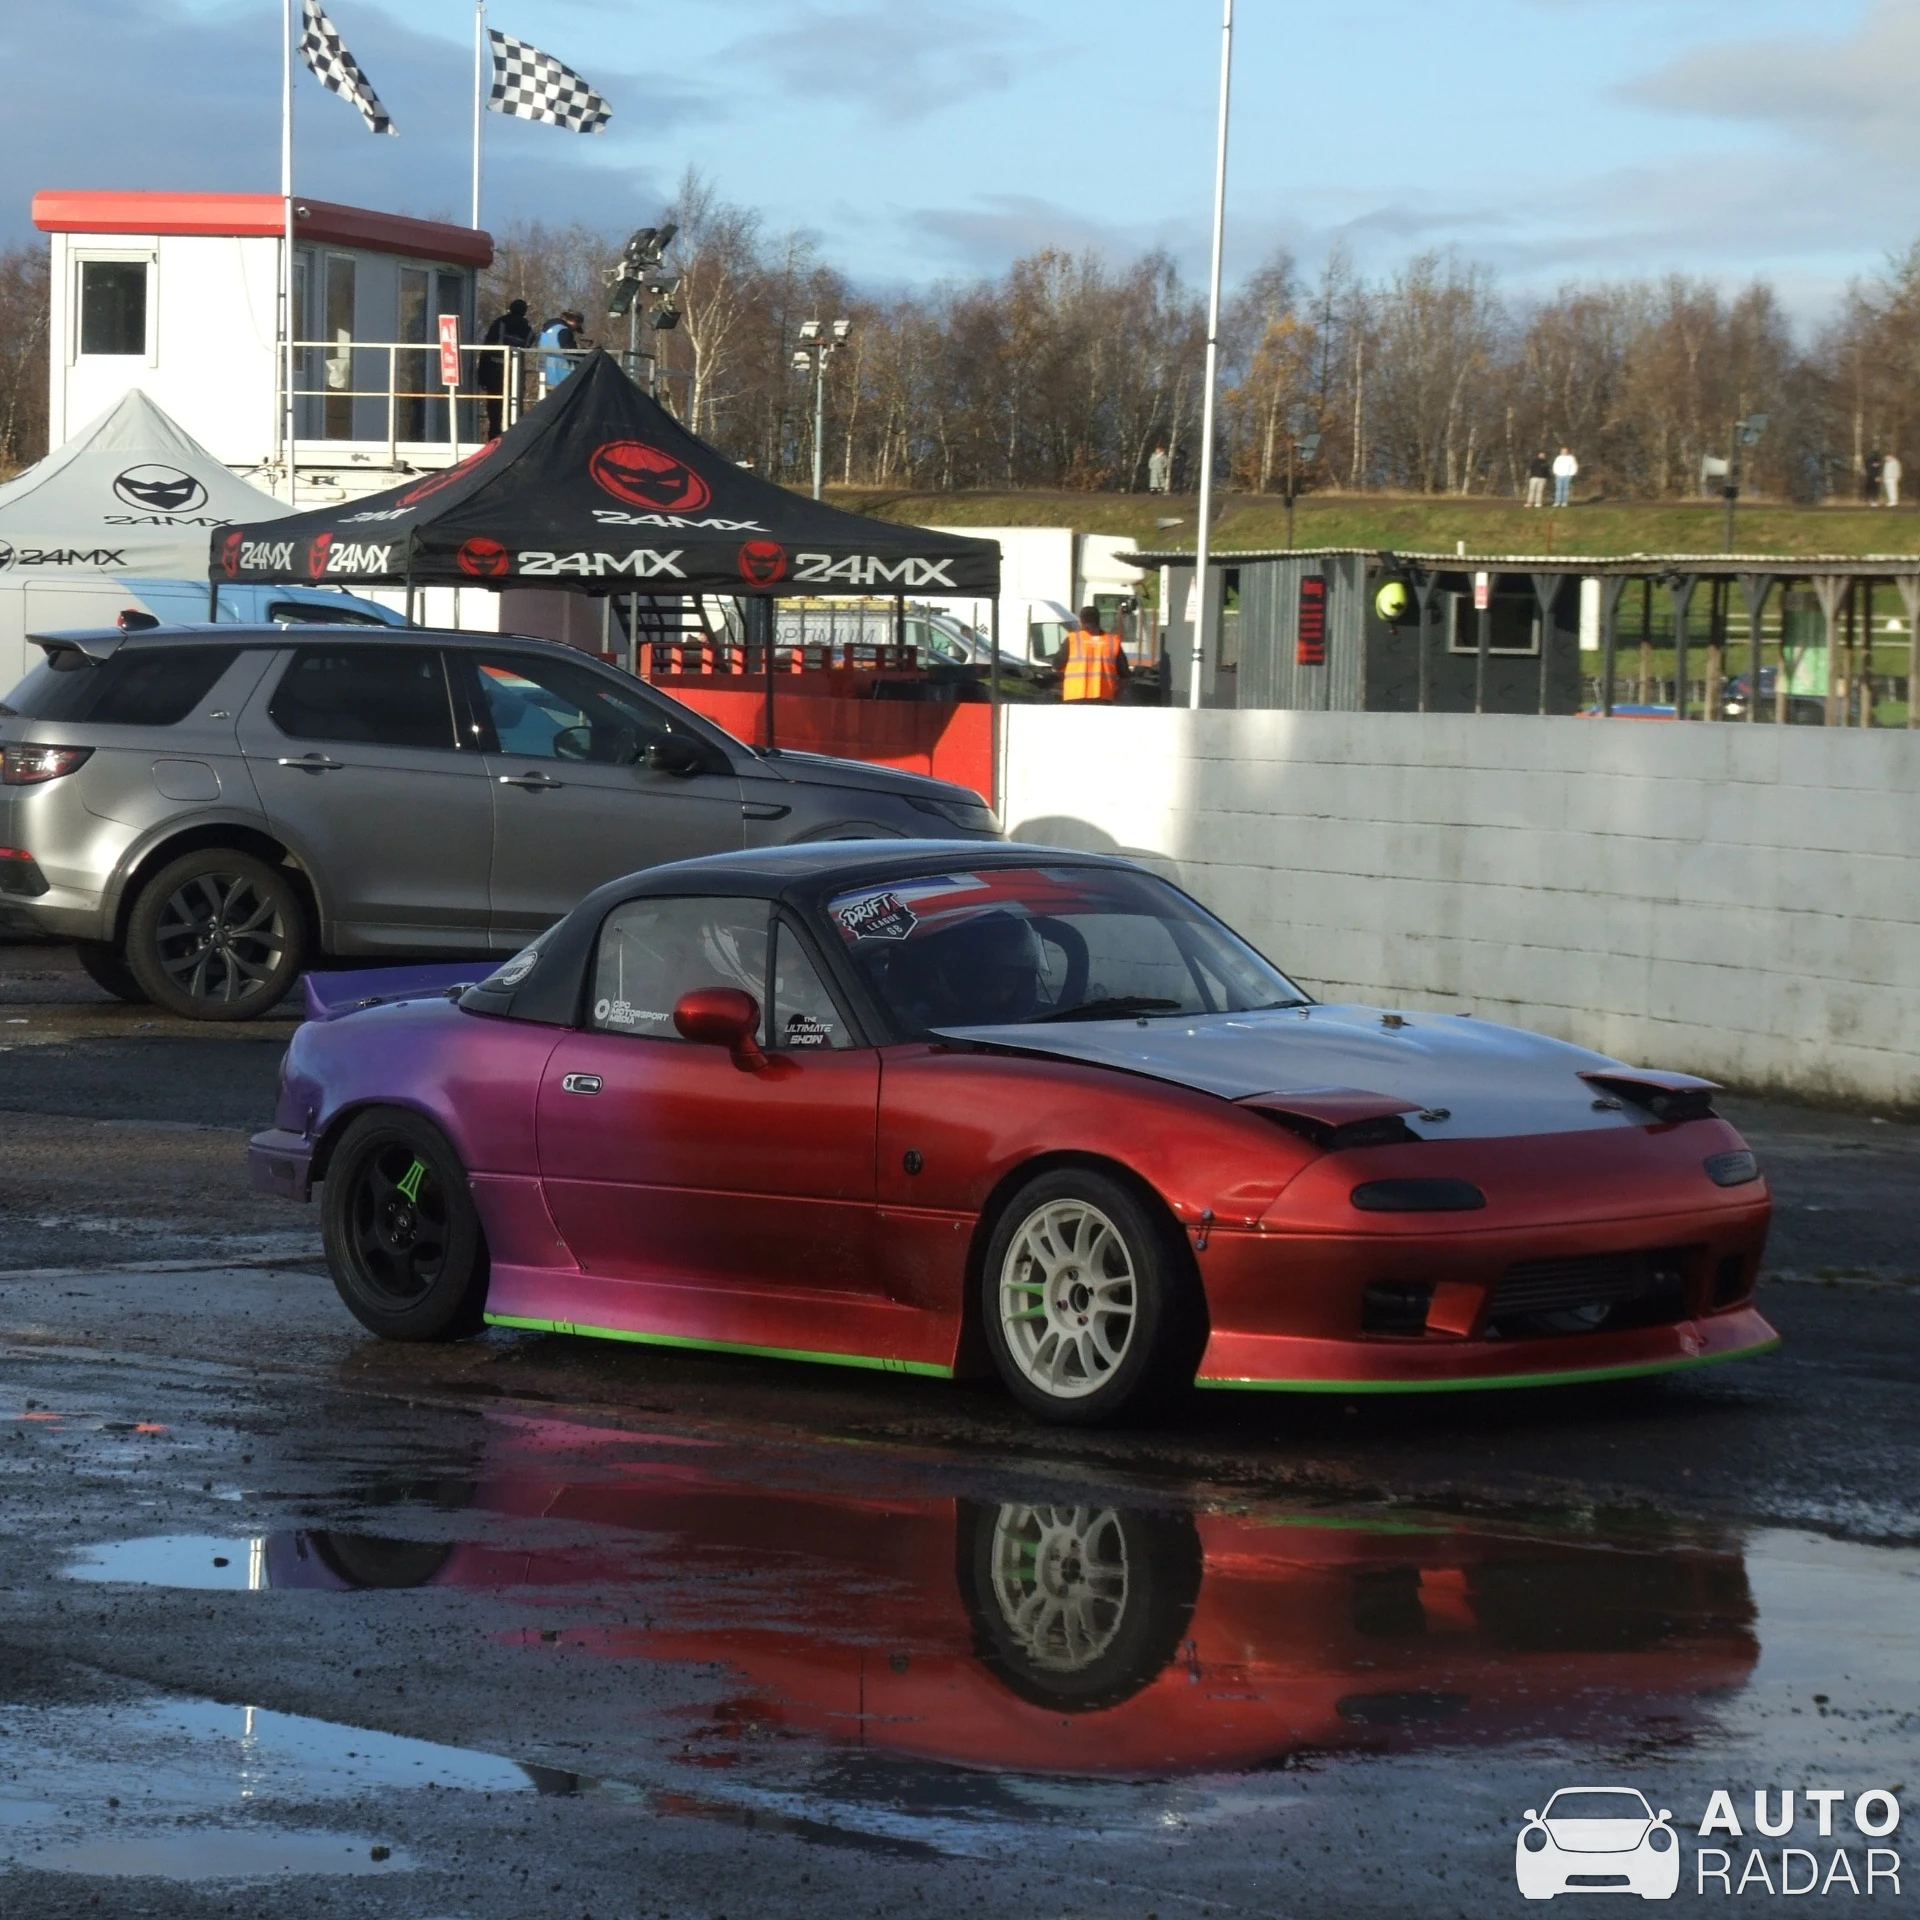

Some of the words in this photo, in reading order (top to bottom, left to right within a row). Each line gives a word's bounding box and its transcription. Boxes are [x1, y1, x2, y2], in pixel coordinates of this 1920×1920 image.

[104, 515, 234, 526] 24MX
[592, 510, 771, 532] 24MX
[19, 549, 127, 565] 24MX
[240, 542, 295, 570] 24MX
[327, 543, 391, 573] 24MX
[518, 549, 688, 578] 24MX
[792, 553, 957, 588] 24MX
[842, 893, 894, 926] DRIFT
[866, 913, 901, 931] LEAGUE
[886, 924, 903, 936] GB
[609, 1014, 635, 1025] MEDIA
[611, 1007, 669, 1022] MOTORSPORT
[784, 1023, 834, 1033] ULTIMATE
[790, 1034, 824, 1045] SHOW
